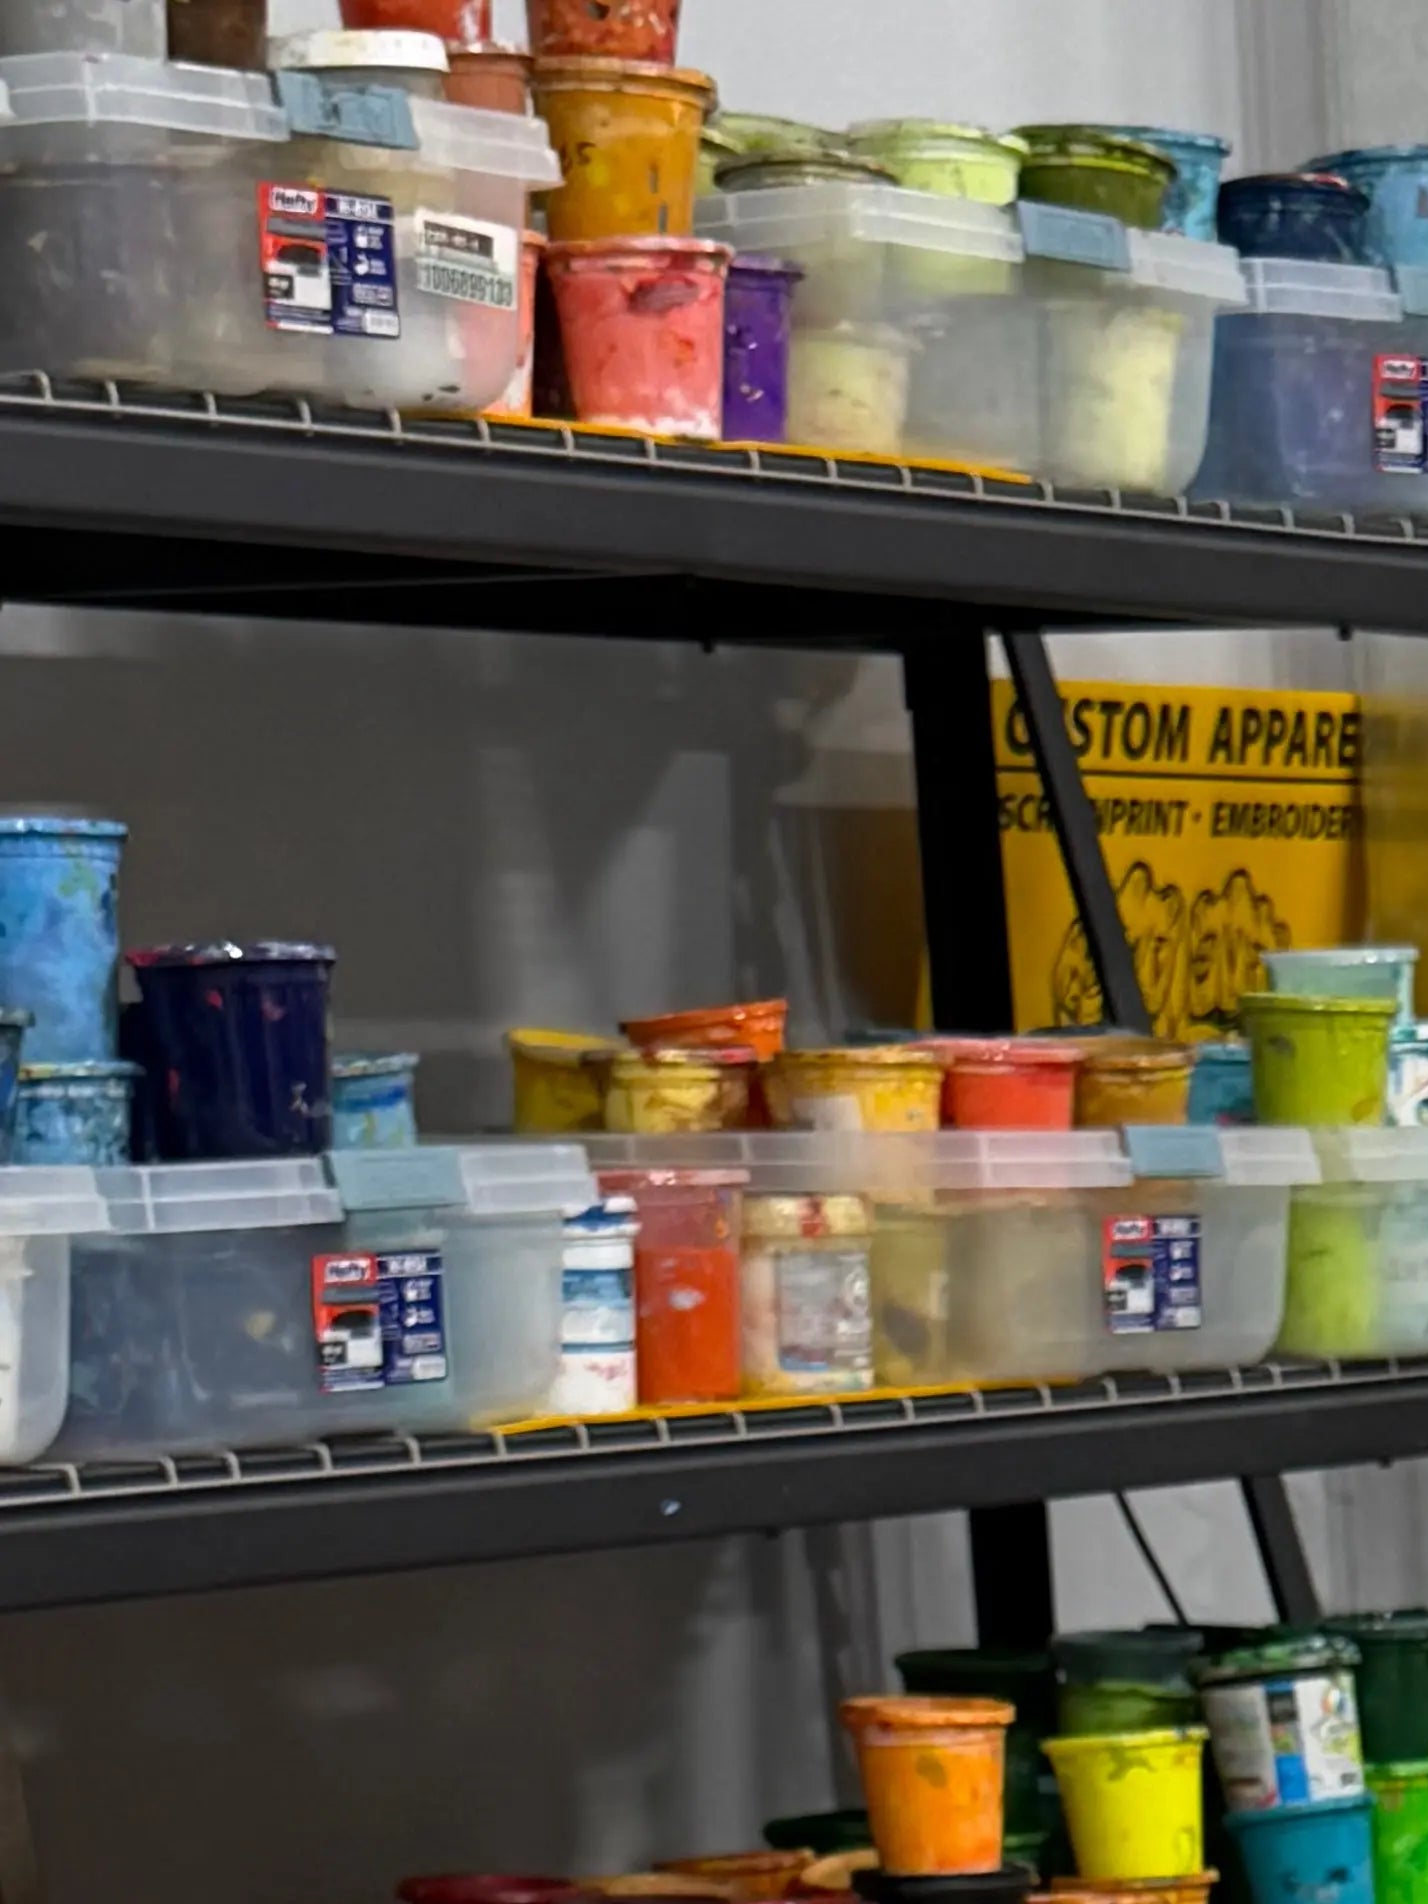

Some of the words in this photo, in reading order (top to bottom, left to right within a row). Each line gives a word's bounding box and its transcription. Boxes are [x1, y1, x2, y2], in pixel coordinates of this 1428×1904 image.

[1005, 696, 1192, 764] CSTOM
[1207, 706, 1362, 768] APPARE
[1211, 800, 1353, 840] EMBROIDER
